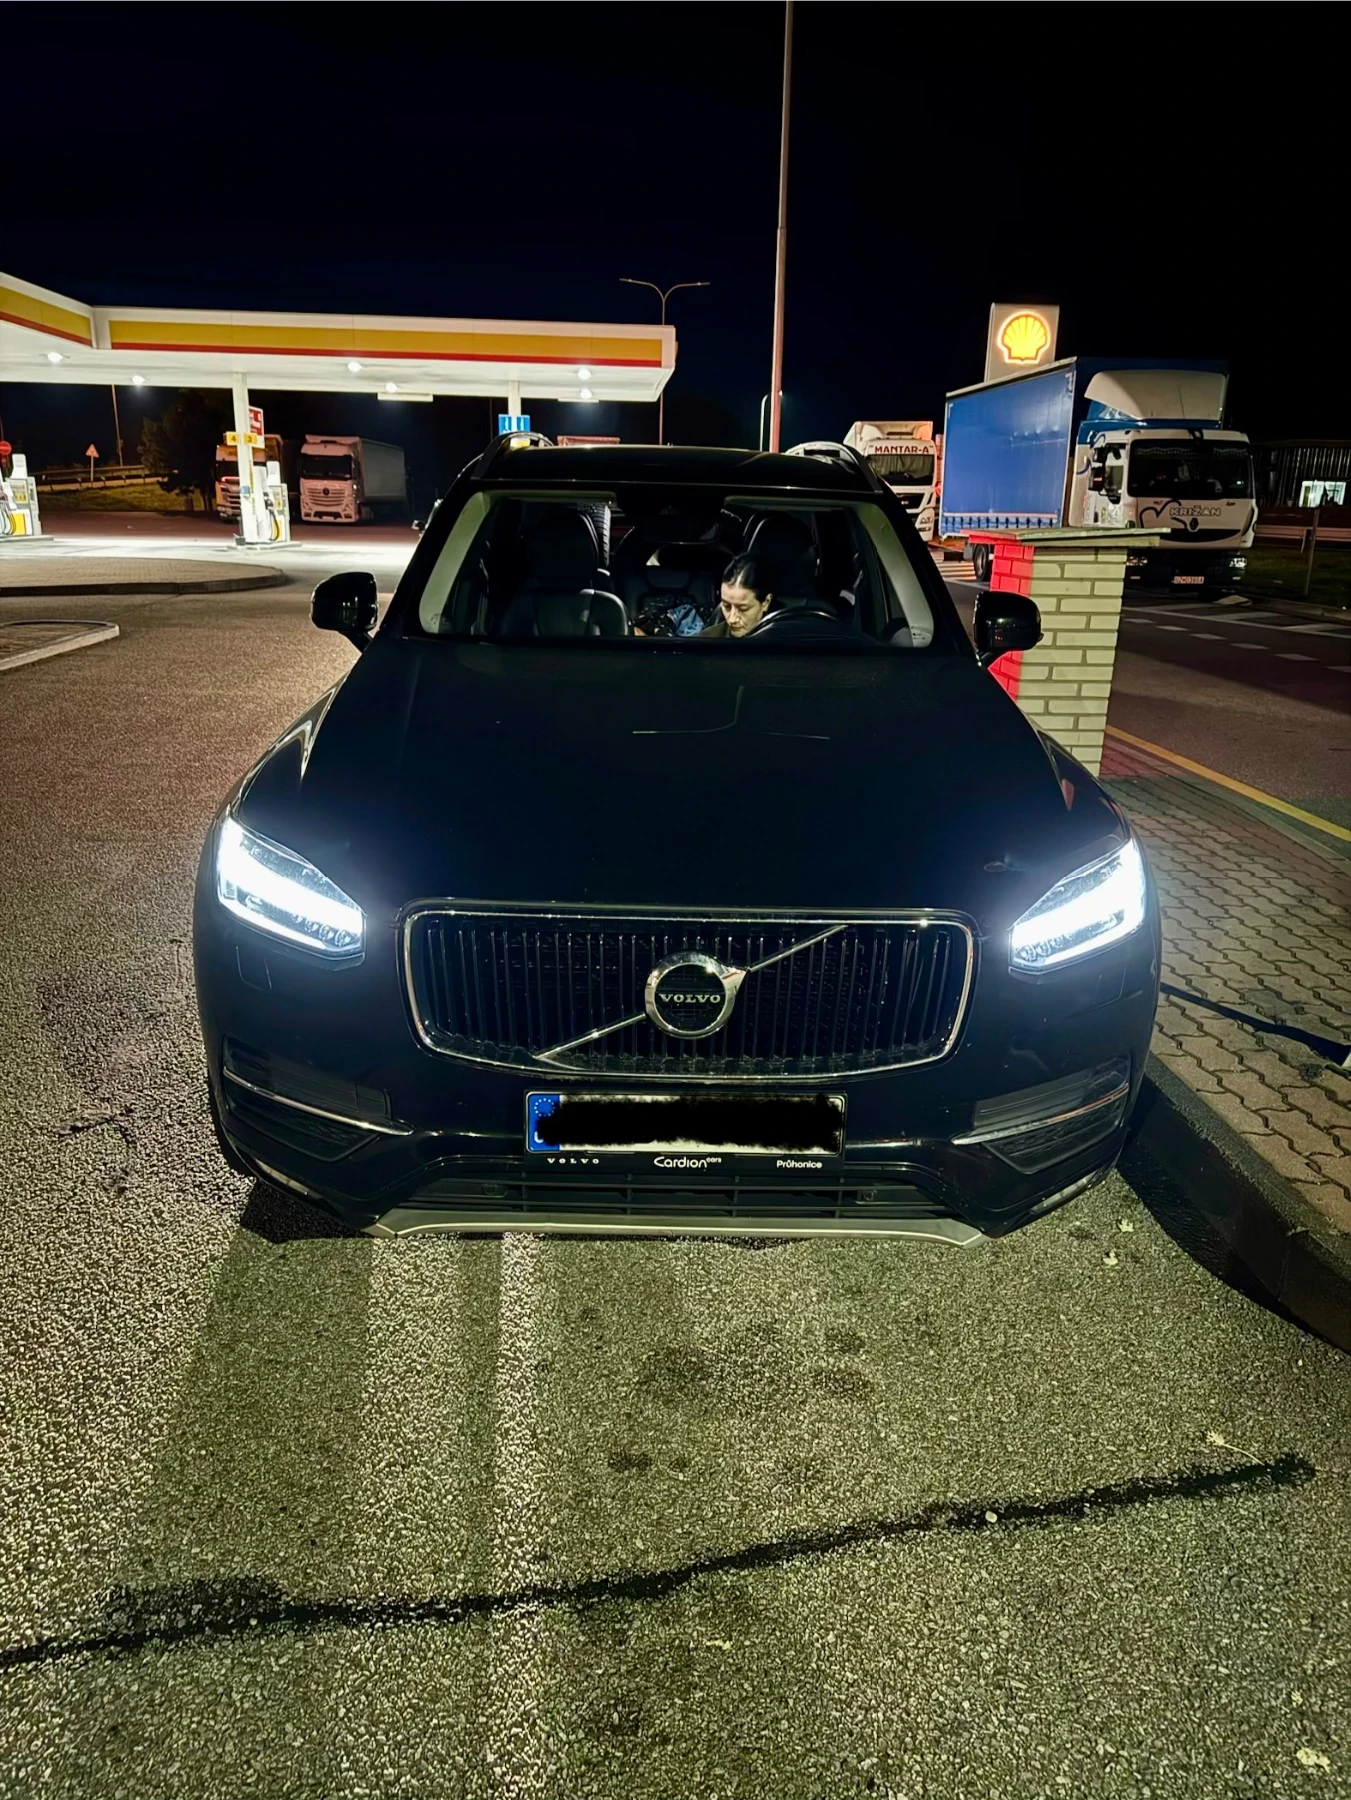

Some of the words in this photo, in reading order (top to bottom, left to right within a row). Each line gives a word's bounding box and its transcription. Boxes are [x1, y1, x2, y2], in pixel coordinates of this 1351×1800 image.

[874, 445, 929, 454] MANTAR-A
[1169, 505, 1221, 516] KRIŽAN
[659, 993, 721, 1003] VOLVO
